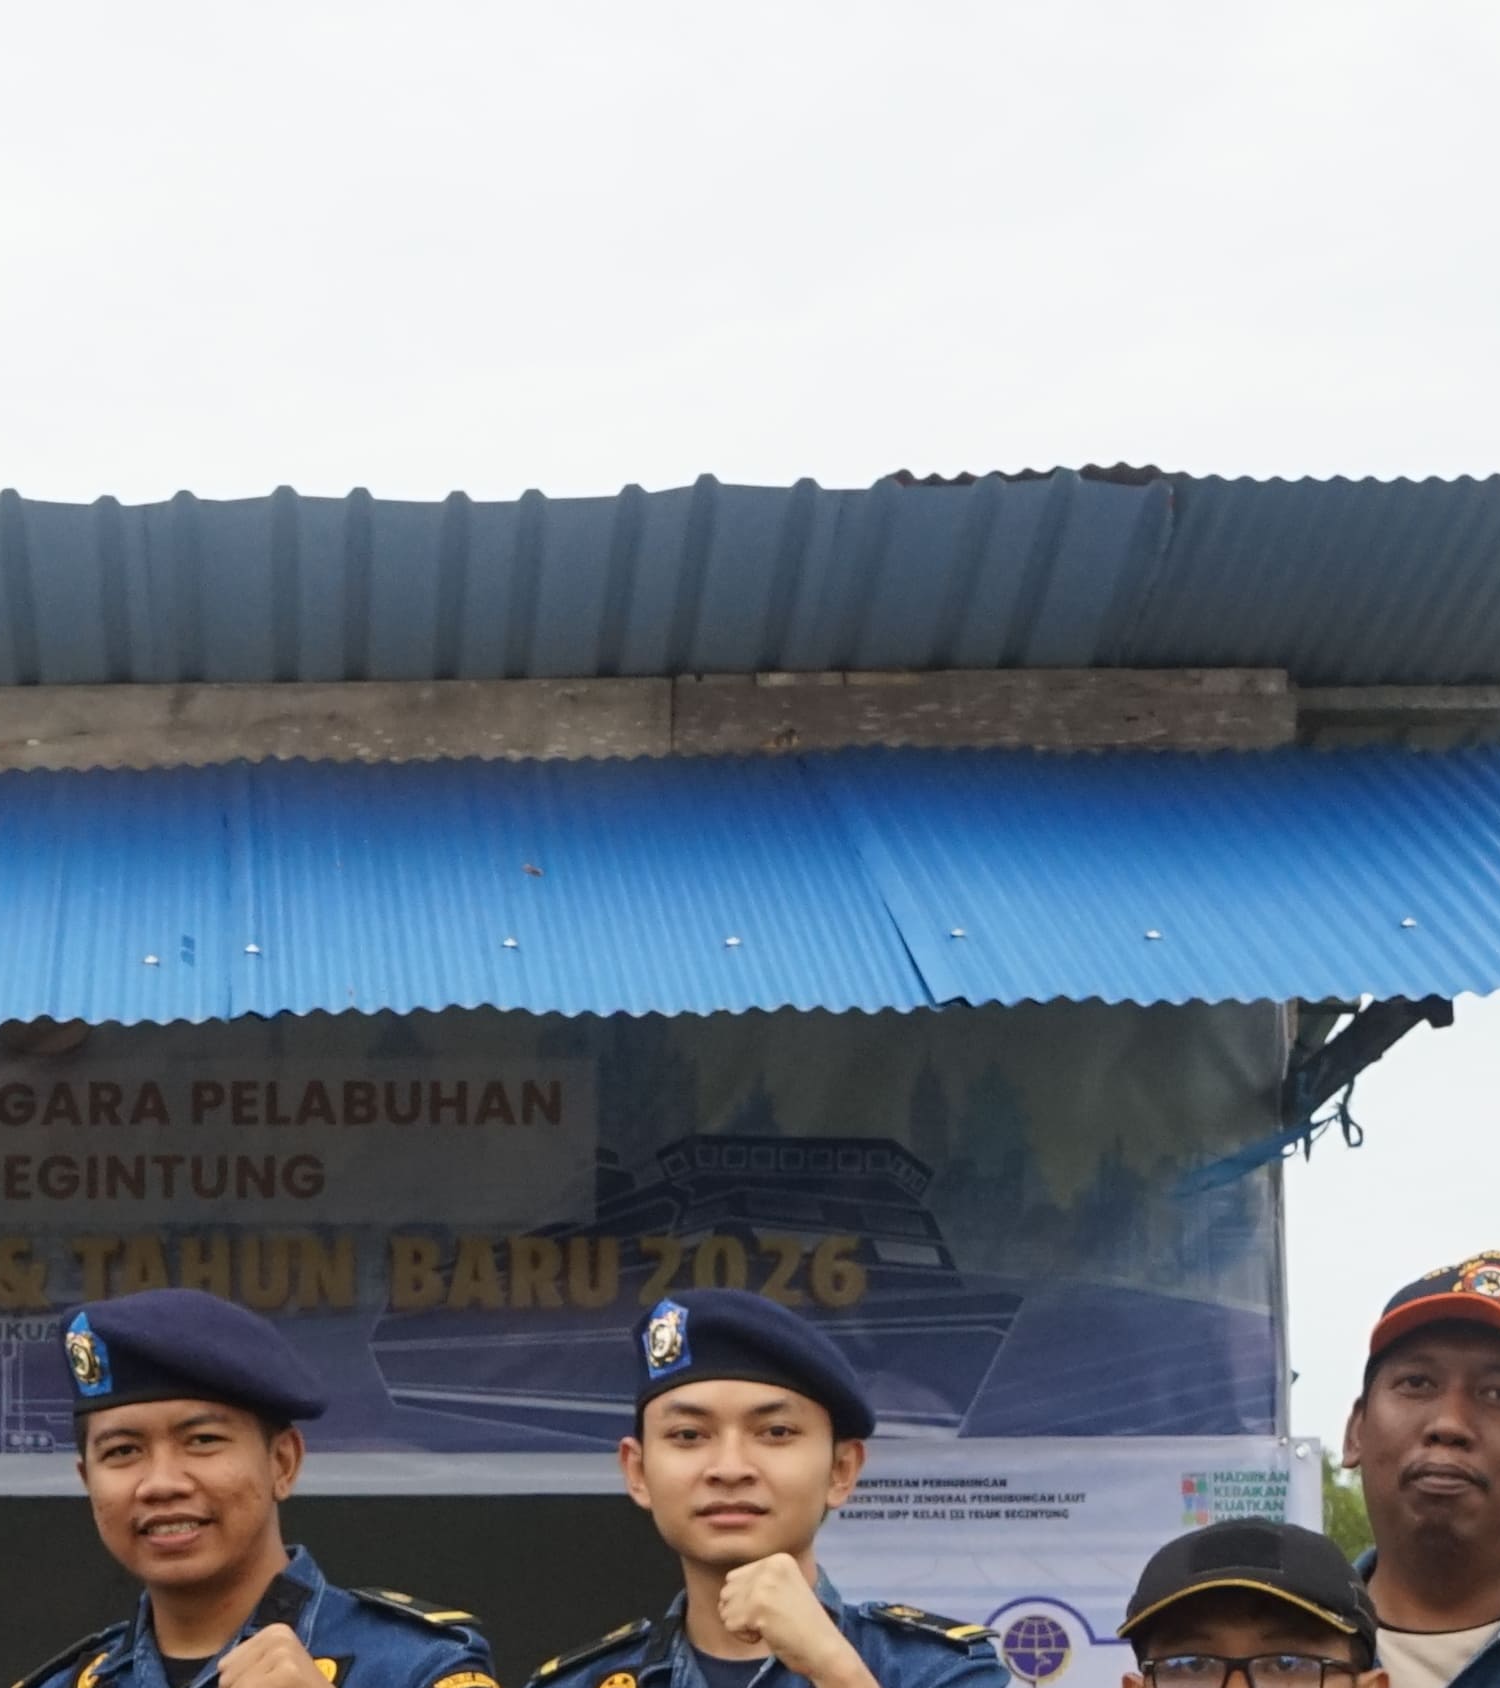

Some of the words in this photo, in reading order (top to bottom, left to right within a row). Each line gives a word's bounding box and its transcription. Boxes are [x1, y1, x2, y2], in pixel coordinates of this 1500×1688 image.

[191, 1079, 562, 1127] PELABUHAN
[72, 1232, 358, 1310] TAHUN
[388, 1232, 621, 1311] BARU
[636, 1232, 870, 1310] 2026
